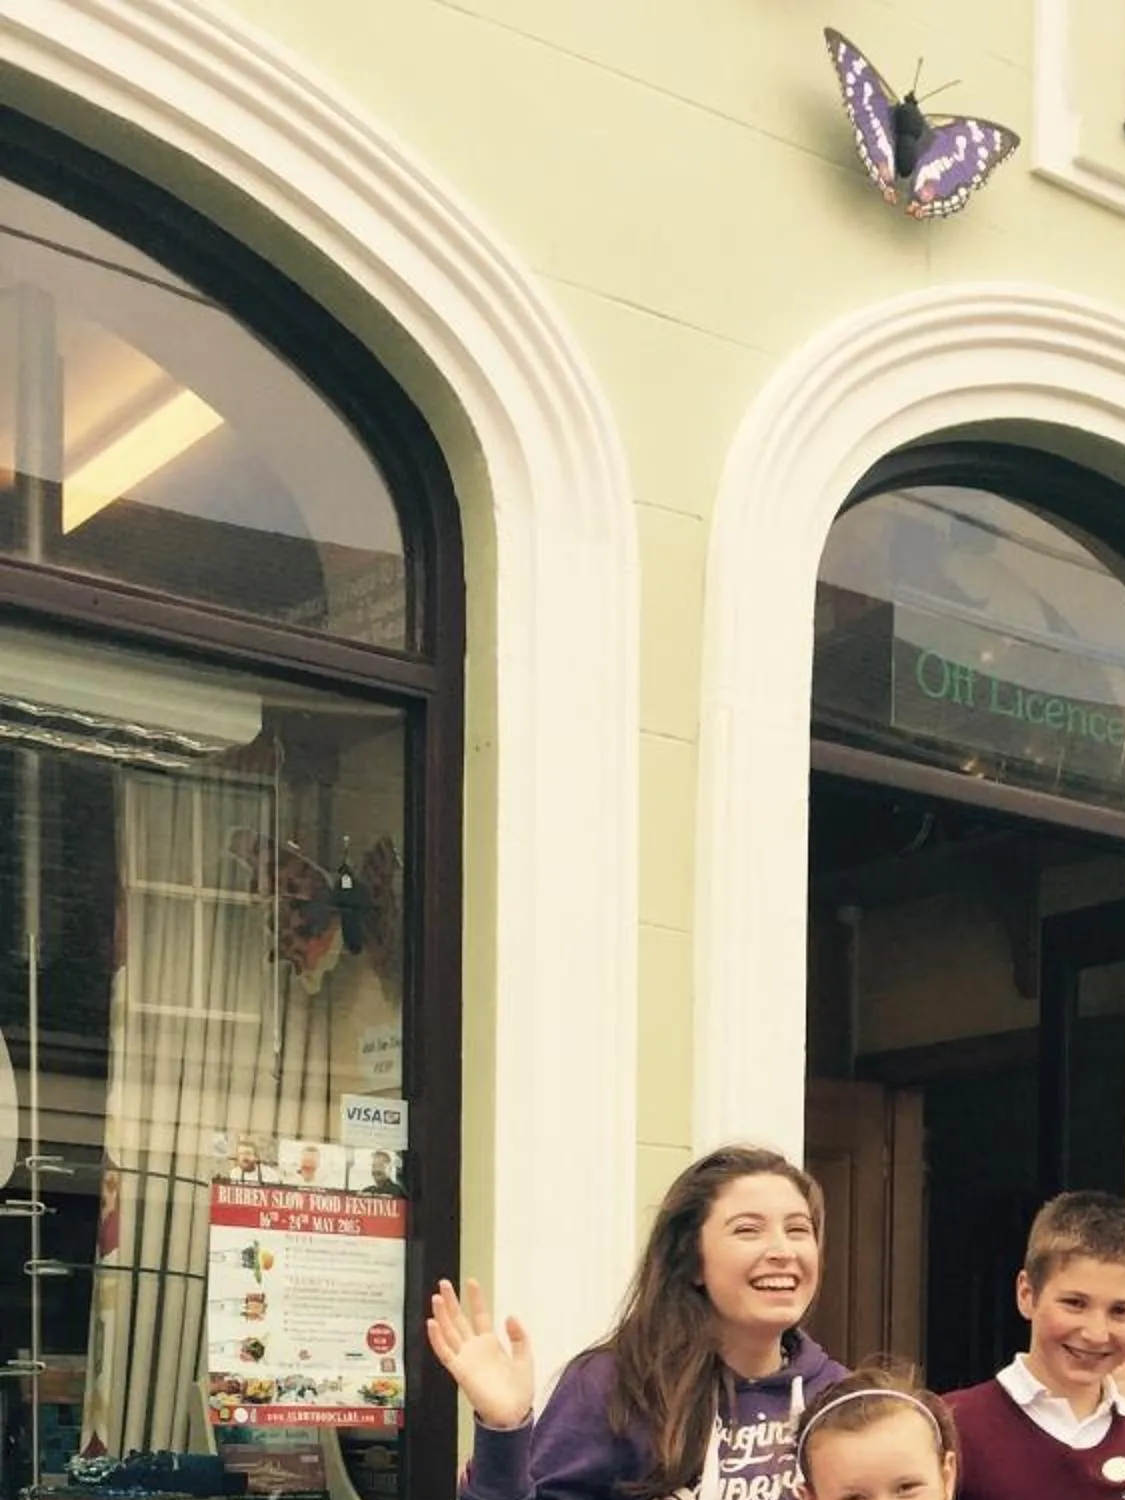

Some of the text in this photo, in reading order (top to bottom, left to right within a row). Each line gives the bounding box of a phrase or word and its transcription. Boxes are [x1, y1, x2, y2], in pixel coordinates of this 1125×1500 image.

[915, 648, 1125, 747] Off Licence
[347, 1106, 382, 1123] VISA
[218, 1186, 400, 1217] BURREN SLOW FOOD FESTIVAL
[312, 1215, 336, 1233] MAY
[712, 1412, 798, 1472] rigin
